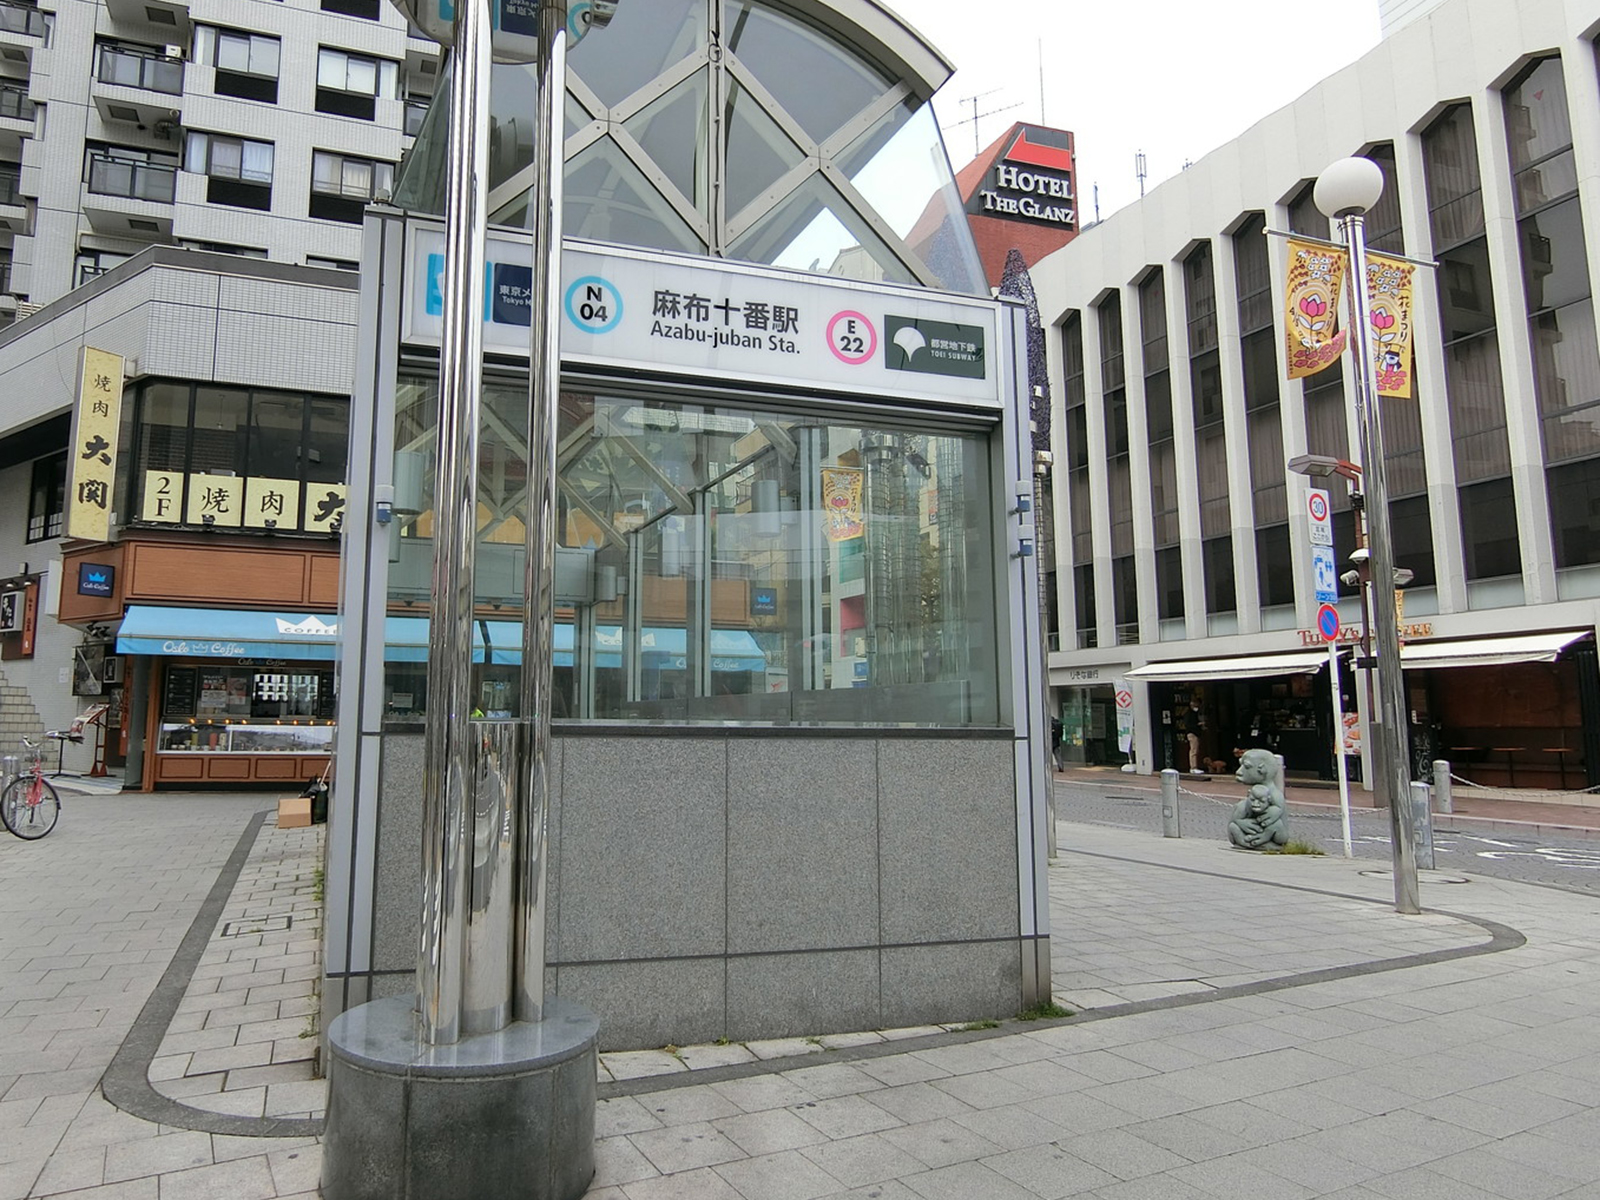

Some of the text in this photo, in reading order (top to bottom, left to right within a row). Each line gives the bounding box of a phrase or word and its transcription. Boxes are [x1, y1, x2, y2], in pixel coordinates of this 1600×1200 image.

[996, 165, 1074, 199] HOTEL
[979, 190, 1076, 224] THE GLANZ
[502, 295, 525, 306] Tokyo
[586, 285, 603, 302] N
[579, 303, 608, 322] 04
[651, 289, 800, 335] 麻布十番駅
[1398, 295, 1411, 343] 花まつり
[846, 320, 855, 334] E
[650, 320, 801, 354] Azabu-juban Sta.
[840, 335, 864, 353] 22
[931, 338, 976, 353] 都営地下鉄
[931, 350, 976, 361] TOEI SUBWAY
[1312, 501, 1324, 514] 30
[163, 640, 245, 656] Oslo Coffee
